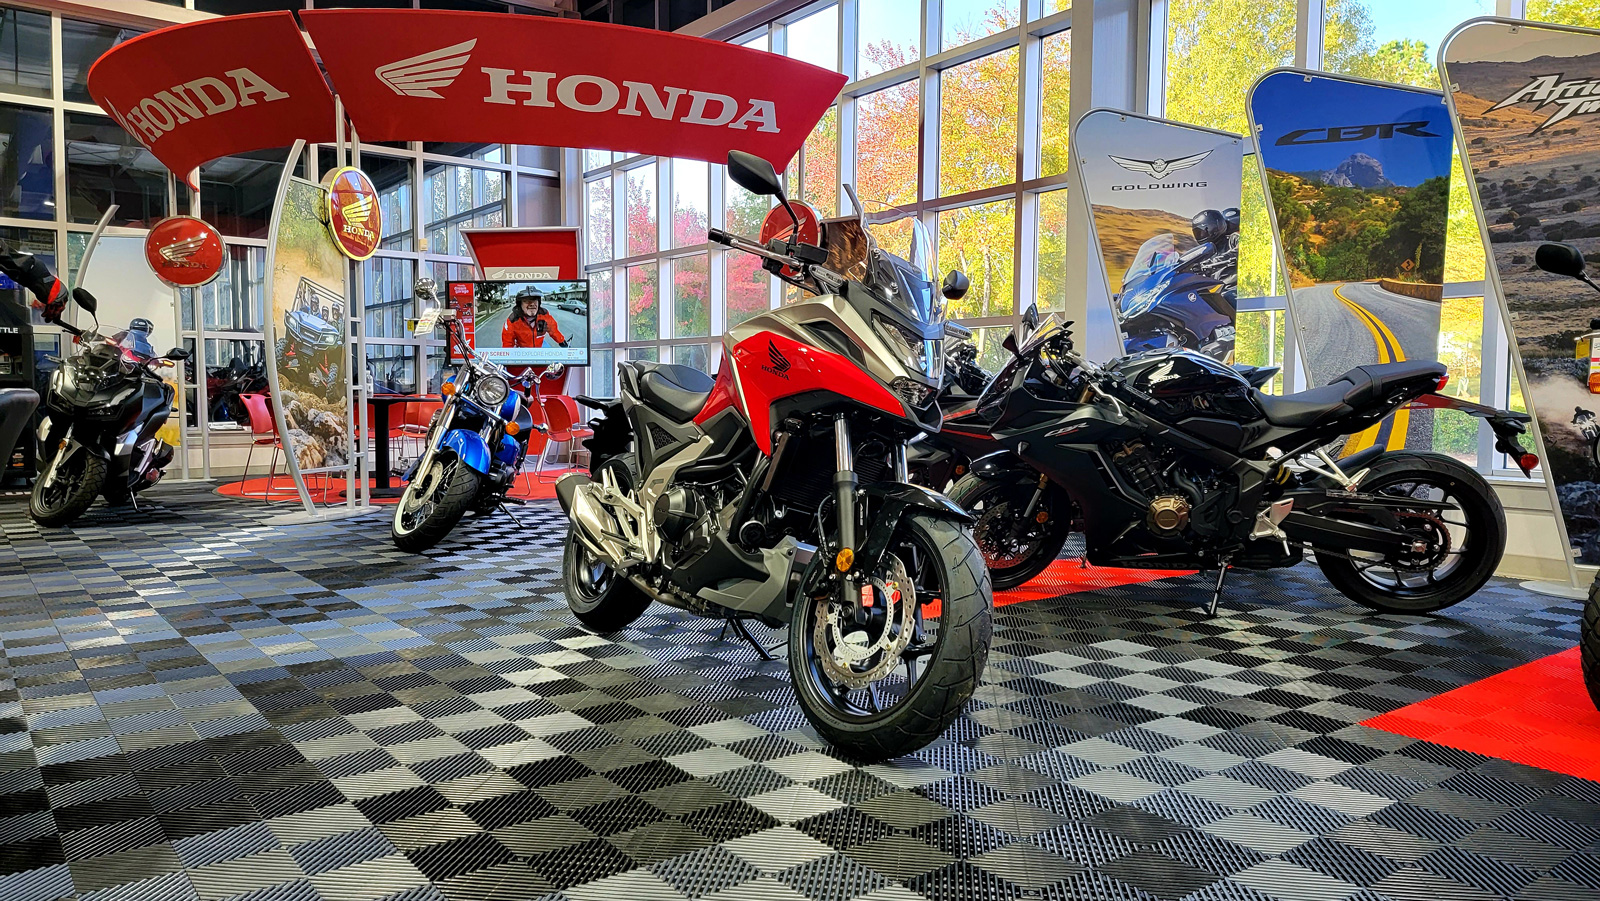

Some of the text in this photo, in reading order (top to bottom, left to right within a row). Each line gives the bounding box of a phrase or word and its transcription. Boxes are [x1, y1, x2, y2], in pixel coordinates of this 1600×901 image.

[127, 67, 290, 143] HONDA
[480, 66, 781, 133] HONDA
[1274, 121, 1442, 146] CBR
[1111, 181, 1208, 192] GOLDWING
[342, 224, 375, 242] HONDA
[505, 272, 552, 280] HONDA
[761, 364, 790, 380] HONDA
[1043, 421, 1090, 437] CBR
[1120, 560, 1205, 569] HONDA
